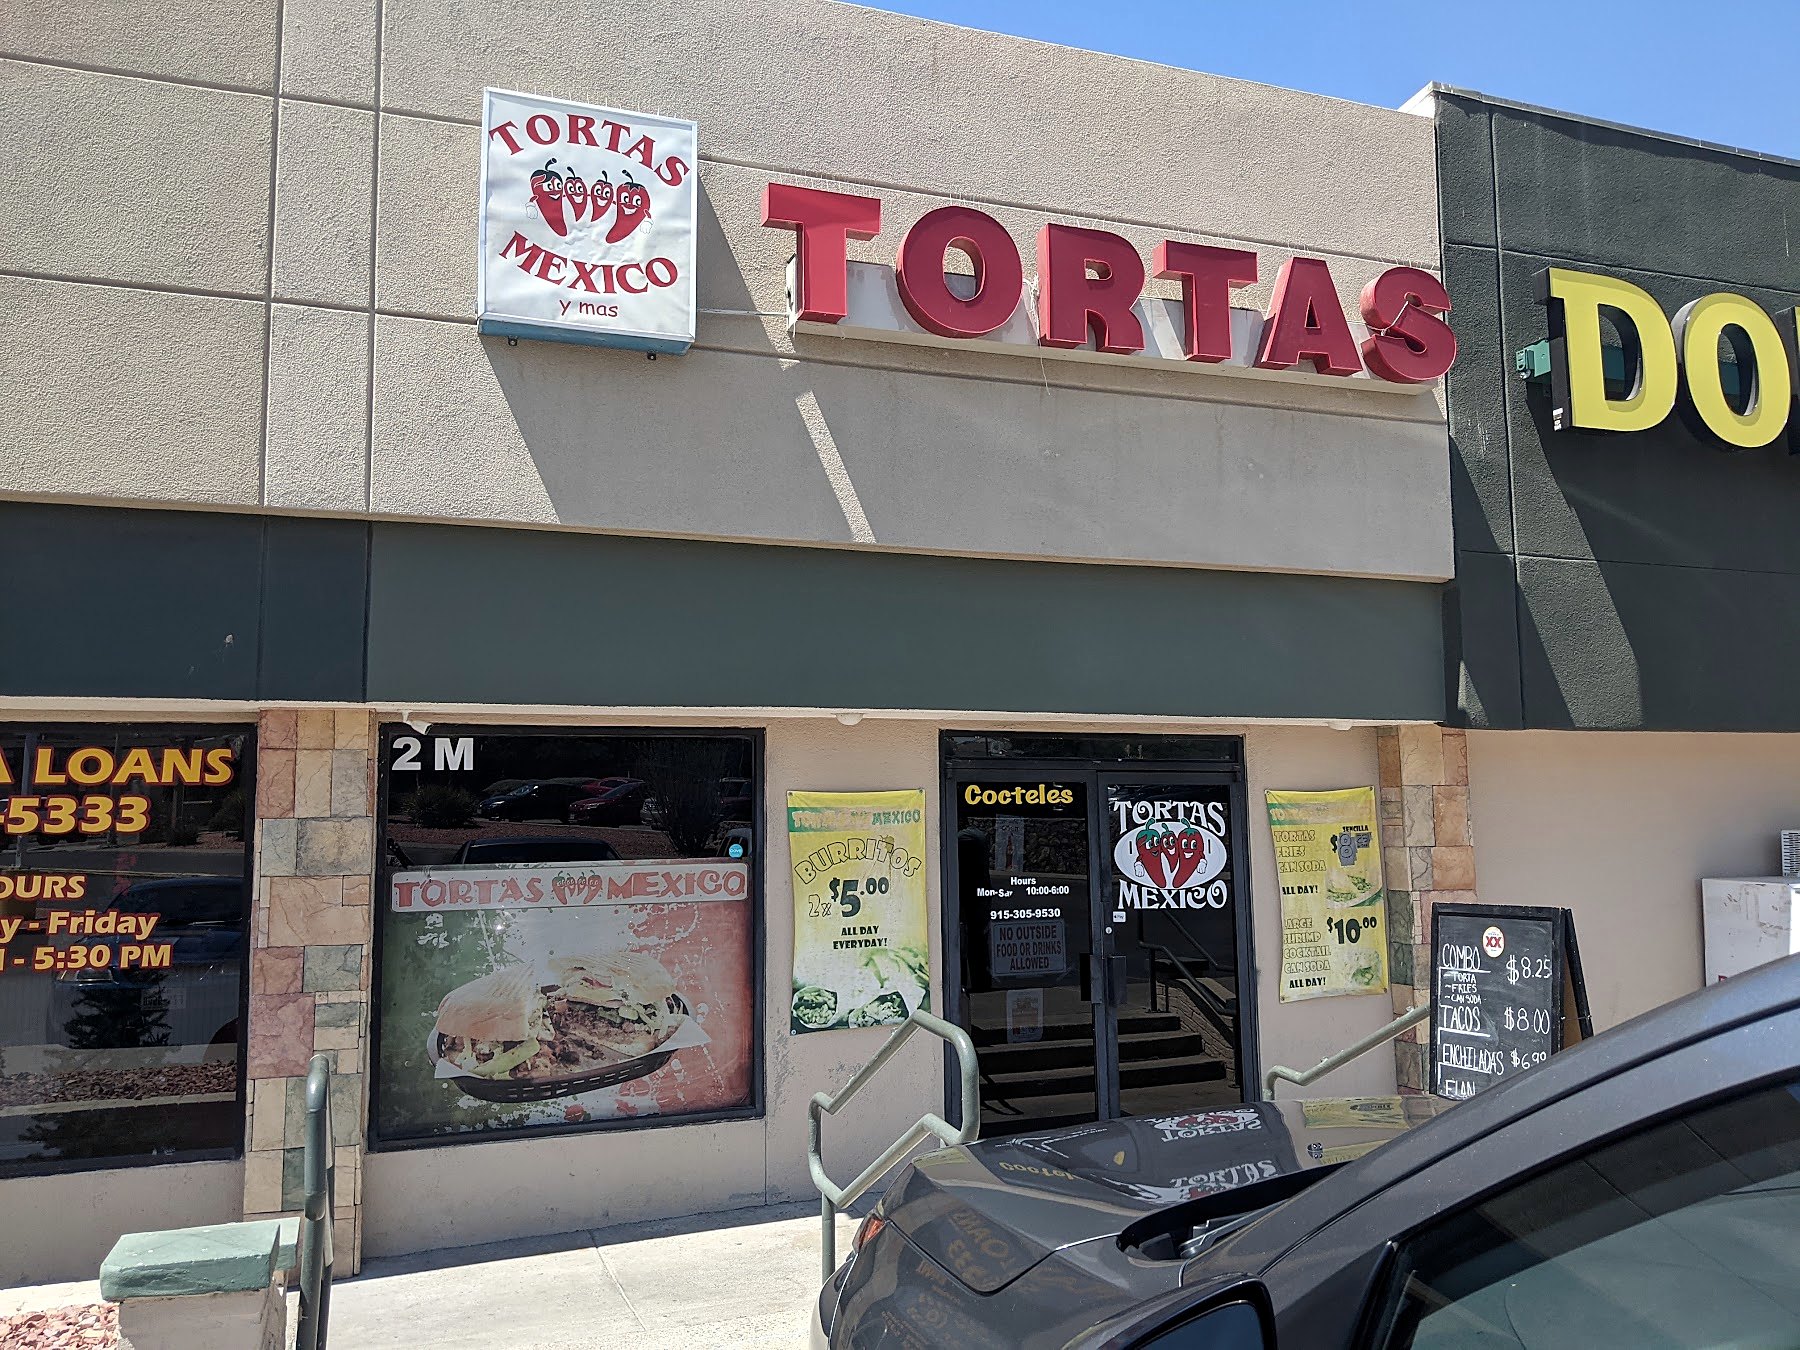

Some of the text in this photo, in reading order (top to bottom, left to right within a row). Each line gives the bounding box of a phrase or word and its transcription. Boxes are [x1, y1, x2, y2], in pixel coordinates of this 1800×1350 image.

[488, 113, 691, 187] TORTAS
[498, 230, 679, 294] MEXICO
[760, 182, 1458, 384] TORTAS
[559, 299, 619, 318] y mas
[1540, 266, 1800, 448] DO
[33, 747, 234, 786] LOANS
[391, 736, 475, 771] 2 M
[964, 783, 1074, 805] Cocteles
[871, 808, 922, 825] MEXICO
[1113, 800, 1226, 837] TORTAS
[1273, 829, 1316, 843] TORTAS
[794, 838, 922, 885] BURRITOS
[1298, 859, 1327, 873] SODA
[394, 869, 746, 908] TORTAS MEXICO
[1010, 876, 1037, 886] Hours
[1025, 886, 1070, 896] 10:00-6:00
[1117, 879, 1228, 909] MEXICO
[1297, 884, 1319, 895] DAY!
[829, 877, 890, 918] $5.00
[48, 909, 159, 941] Friday
[990, 908, 1061, 920] 915-305-9530
[832, 938, 888, 950] EVERYDAY!
[840, 925, 879, 937] ALL DAY
[1000, 925, 1057, 940] NO OUTSIDE
[1327, 916, 1377, 945] $10.00
[33, 945, 111, 971] 5:30
[120, 943, 172, 969] PM
[996, 941, 1062, 957] FOOD OR DRINKS
[1010, 956, 1050, 971] ALLOWED
[1442, 943, 1552, 985] COMBO $8.25
[1289, 976, 1327, 989] ALL DAY!
[1440, 1004, 1481, 1032] TACOS
[1442, 1043, 1505, 1076] ENCHILADAS
